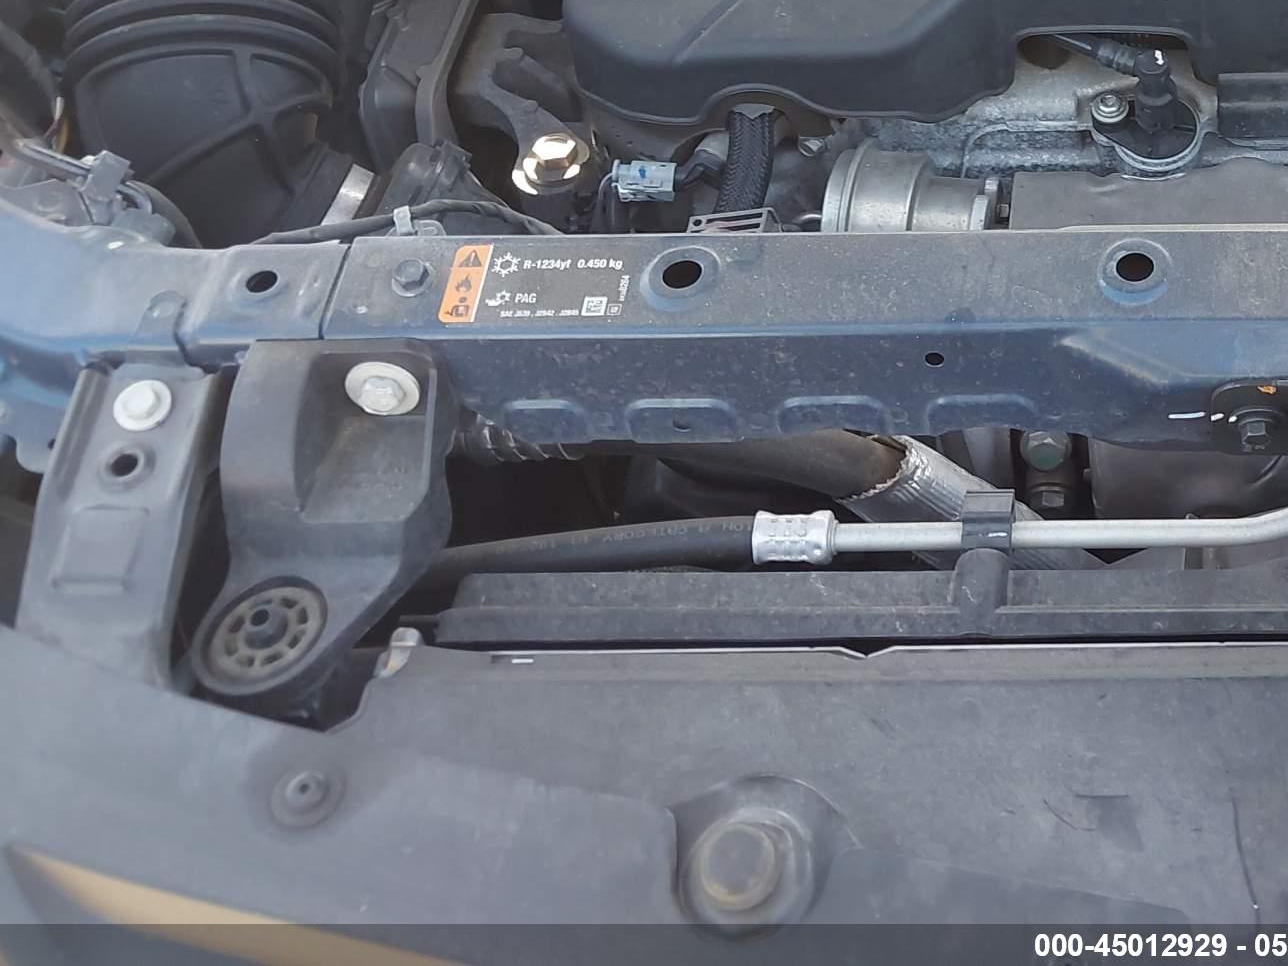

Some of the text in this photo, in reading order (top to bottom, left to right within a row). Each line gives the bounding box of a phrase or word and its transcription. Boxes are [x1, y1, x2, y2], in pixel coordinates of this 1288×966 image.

[523, 259, 623, 271] R-1234yf 0.450 kg
[515, 293, 537, 304] PAG
